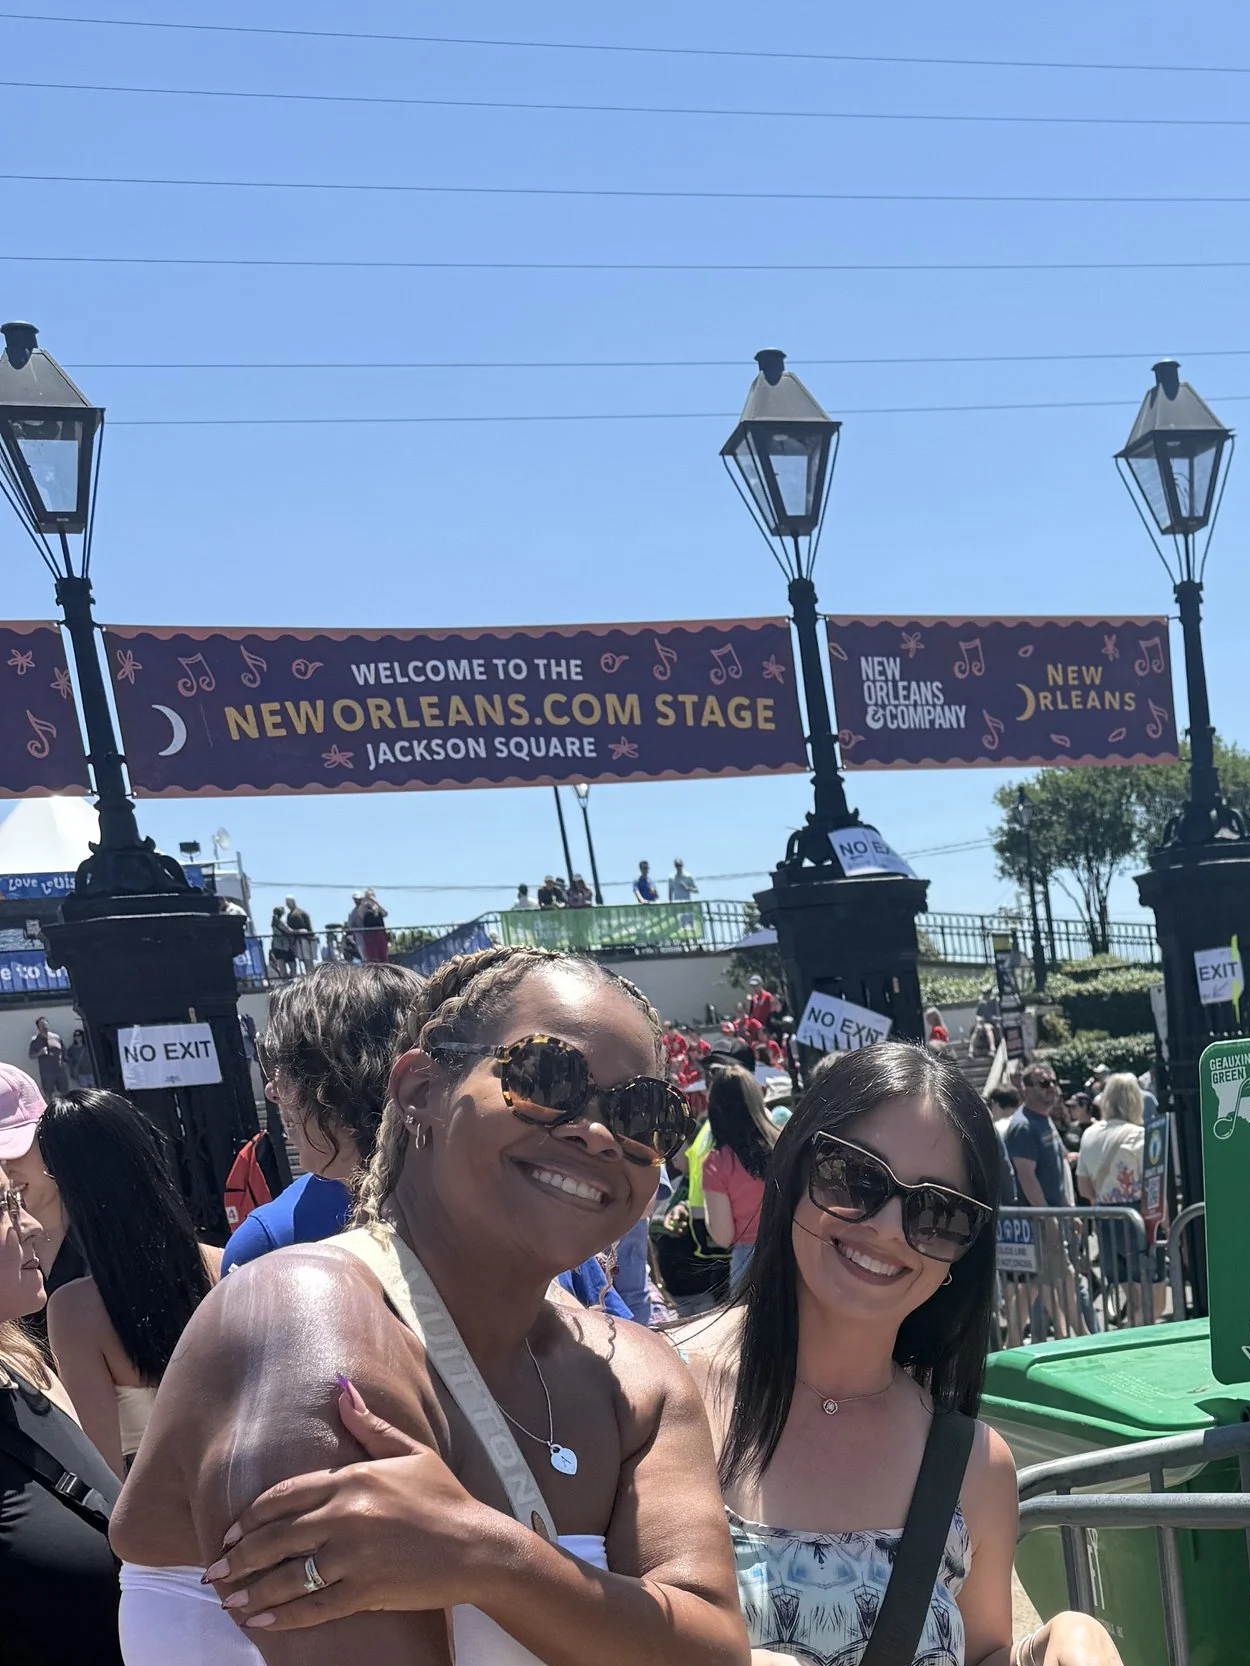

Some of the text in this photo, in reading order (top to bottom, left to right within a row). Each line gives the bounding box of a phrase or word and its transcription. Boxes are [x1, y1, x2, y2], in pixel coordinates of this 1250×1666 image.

[351, 658, 583, 686] WELCOME TO THE
[860, 656, 900, 681] NEW
[1046, 663, 1103, 687] NEW
[863, 680, 944, 705] ORLEANS
[224, 693, 776, 741] NEWORLEANS.COM STAGE
[865, 704, 967, 730] &COMPANY
[366, 736, 597, 771] JACKSON SQUARE
[839, 841, 868, 857] NO
[1199, 962, 1239, 981] EXIT
[808, 1007, 884, 1044] NO EXIT
[123, 1040, 211, 1063] NO EXIT
[1212, 1067, 1247, 1085] GREEN
